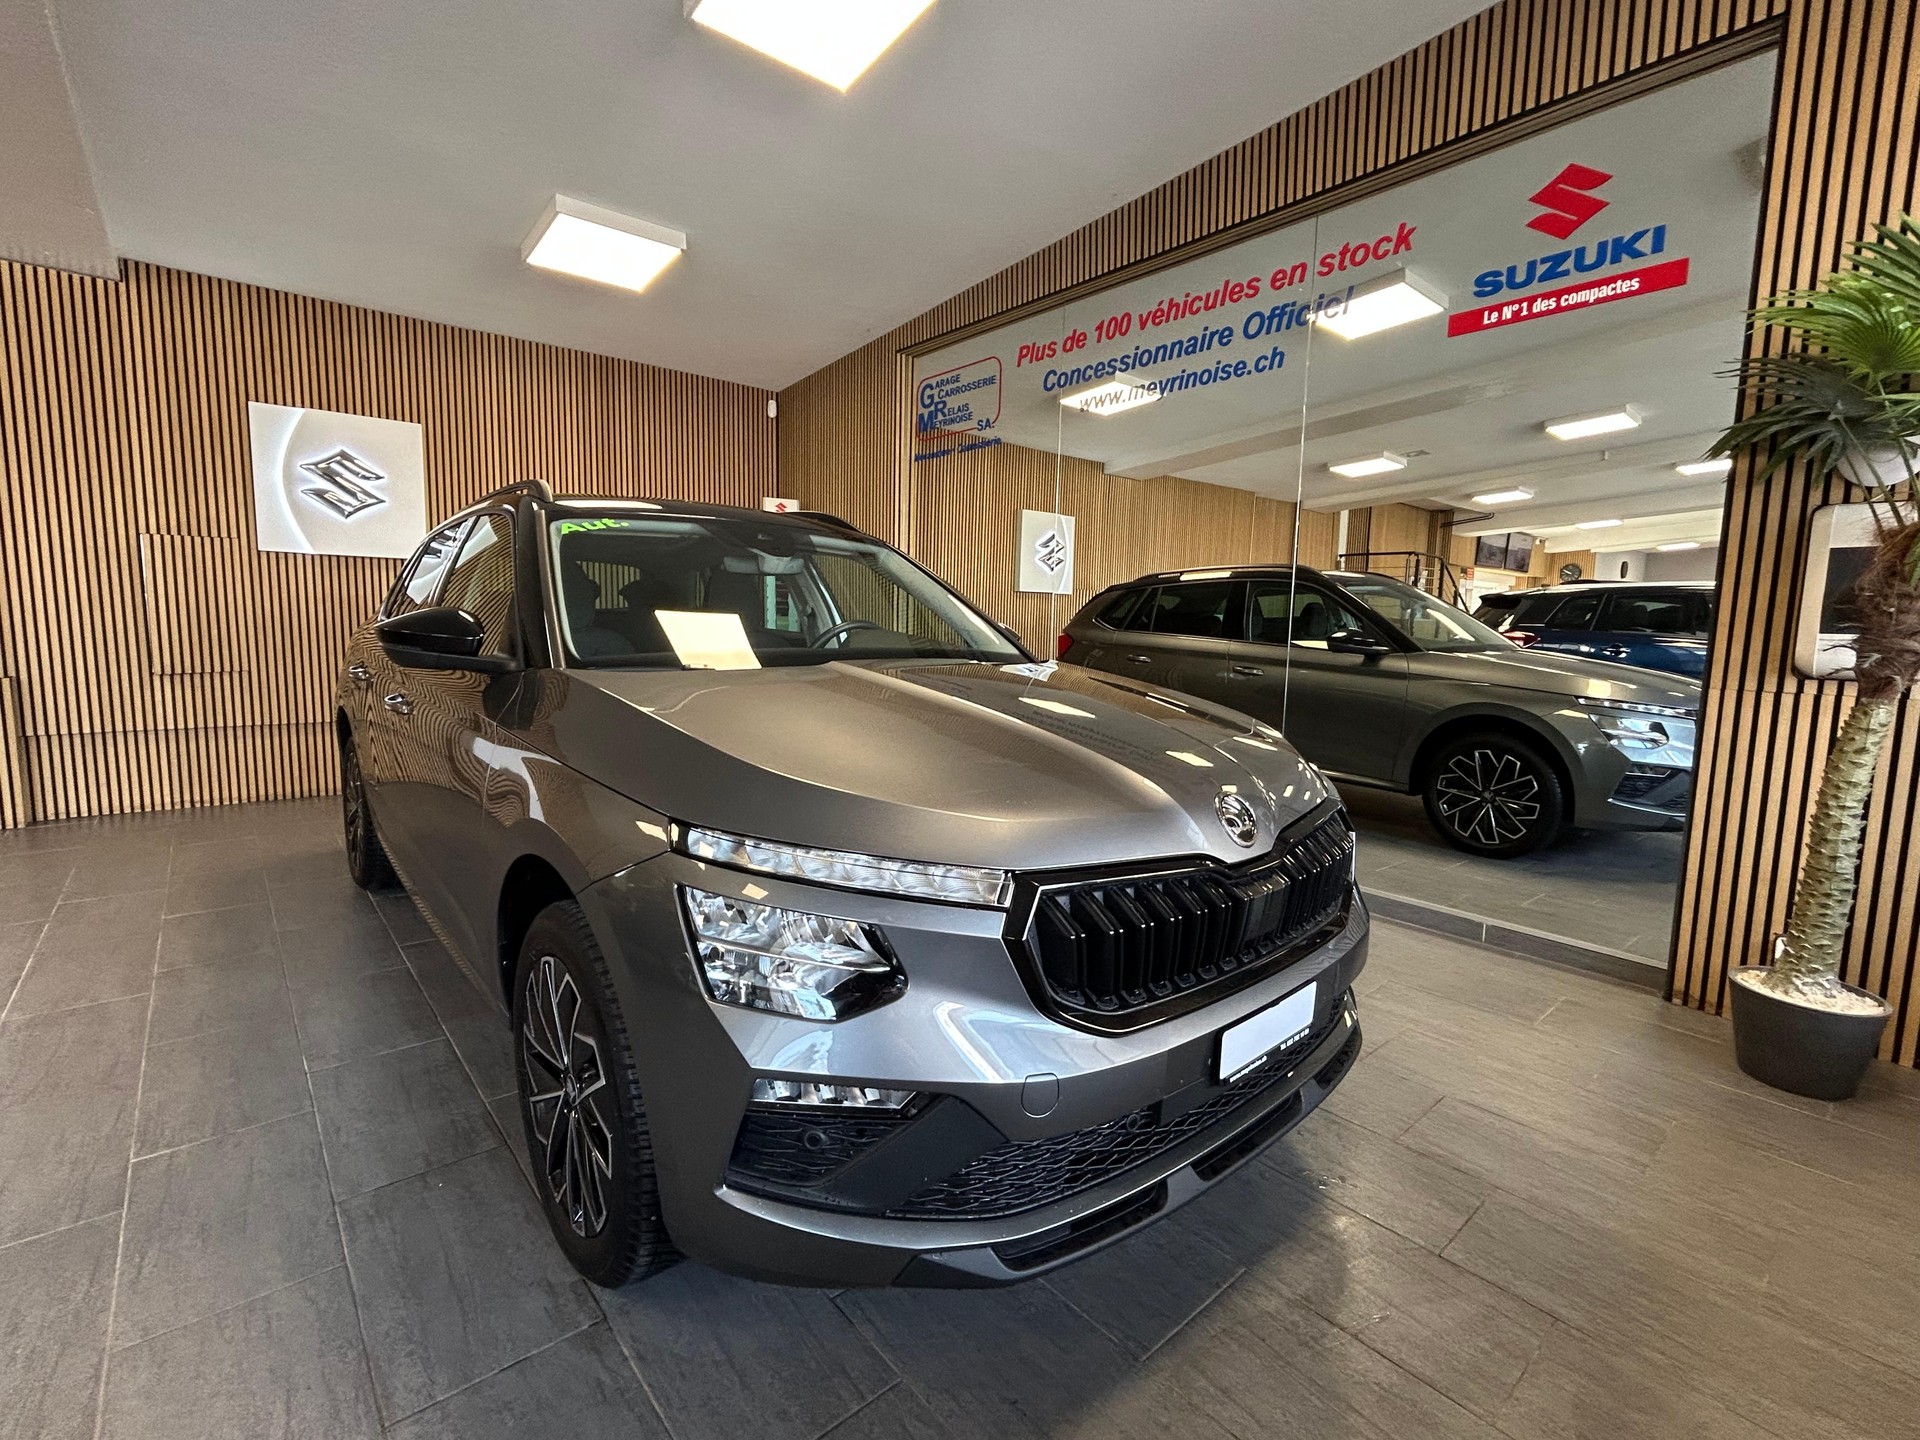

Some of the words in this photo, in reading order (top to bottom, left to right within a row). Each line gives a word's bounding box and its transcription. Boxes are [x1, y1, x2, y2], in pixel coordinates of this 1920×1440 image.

[1473, 224, 1667, 298] SUZUKI
[1016, 341, 1058, 368] Plus
[1062, 328, 1088, 353] de
[1094, 311, 1132, 344] 100
[1137, 276, 1261, 331] véhicules
[1269, 261, 1308, 291] en
[1316, 222, 1417, 277] stock
[1483, 310, 1499, 325] Le
[1501, 301, 1529, 321] N°1
[1532, 297, 1557, 314] des
[1560, 277, 1641, 307] compactes
[1043, 325, 1235, 392] Concessionnaire
[1242, 285, 1355, 340] Officiel
[937, 375, 998, 400] CARROSSERIE
[1079, 346, 1286, 413] www.meyrinoise.ch
[917, 411, 974, 433] MEYRINOISE
[933, 400, 970, 421] RELAIS
[561, 517, 630, 535] Aut.
